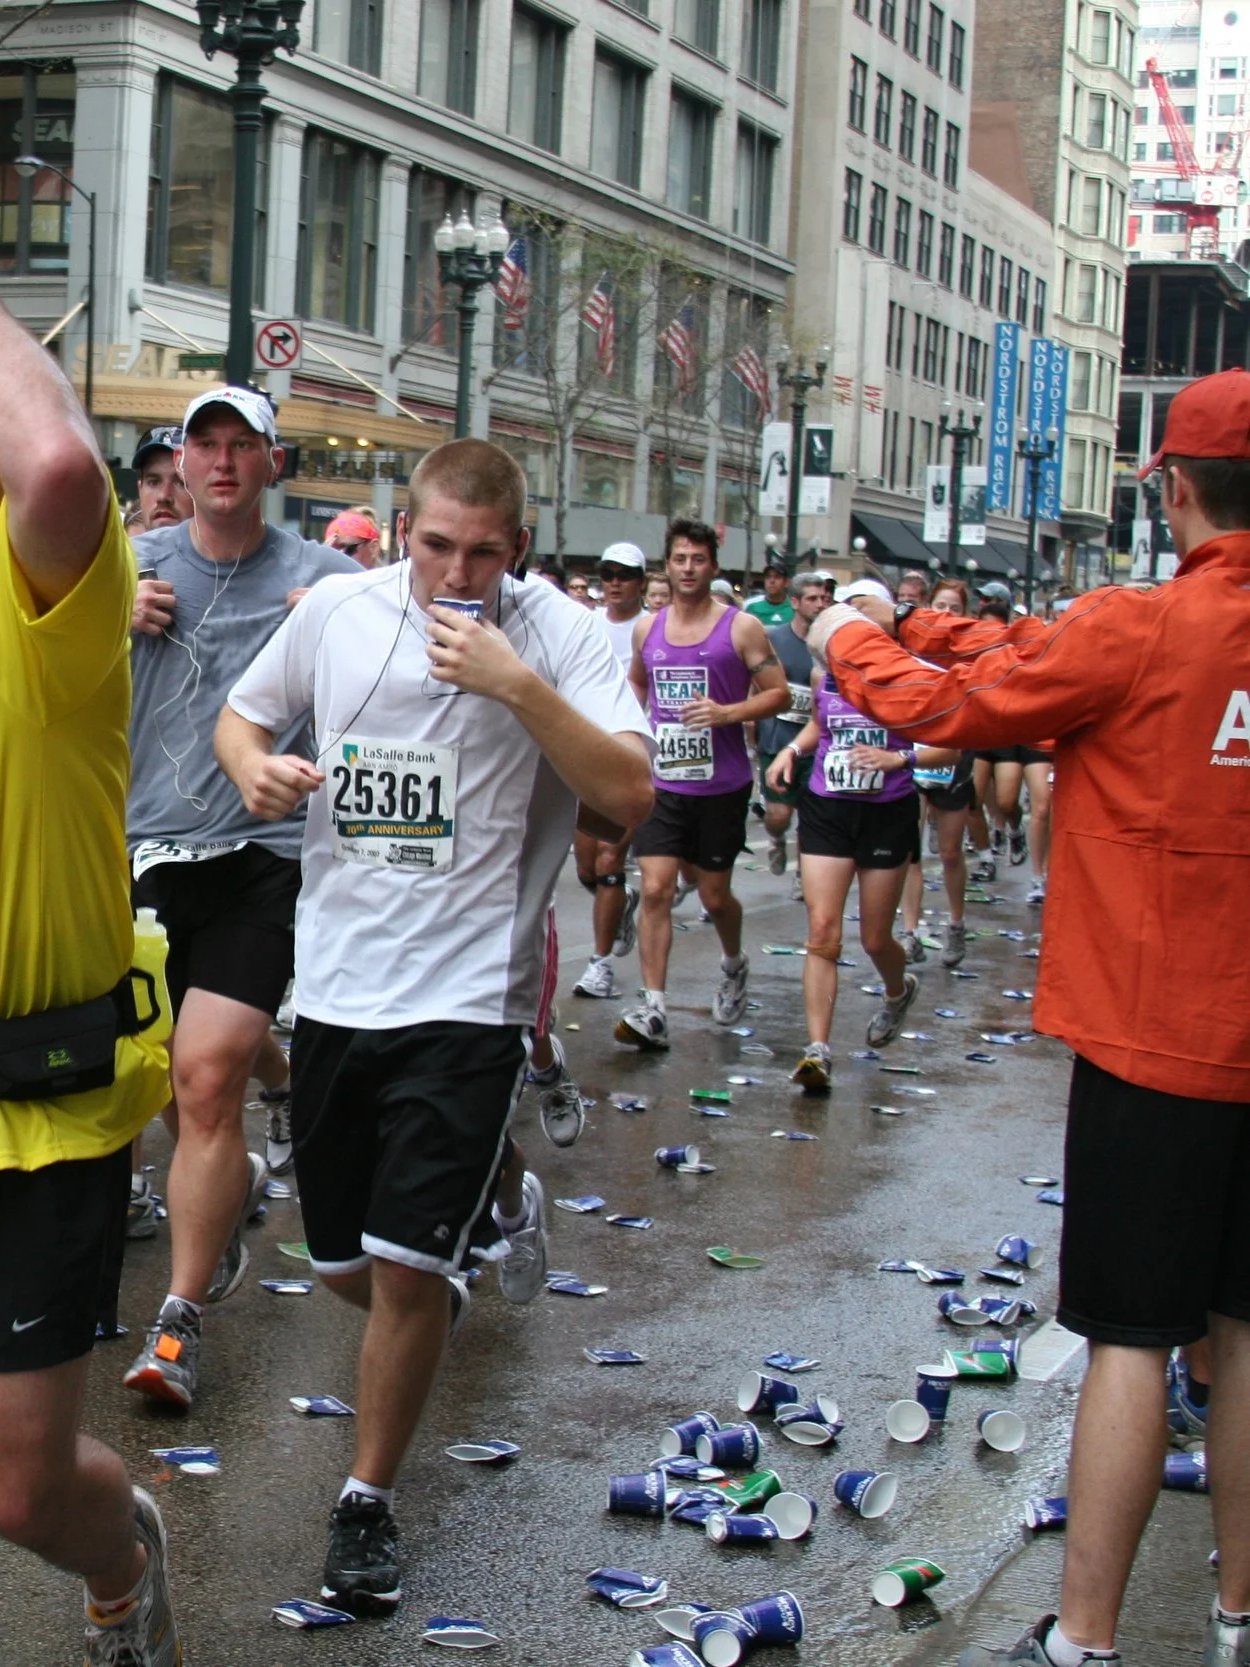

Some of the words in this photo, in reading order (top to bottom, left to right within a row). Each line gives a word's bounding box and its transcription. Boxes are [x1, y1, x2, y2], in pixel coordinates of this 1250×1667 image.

[11, 118, 75, 142] SEA
[993, 324, 1014, 449] NORDSTROM
[304, 460, 396, 478] SEARS
[656, 682, 706, 699] TEAM
[836, 729, 886, 746] TEAM
[363, 747, 404, 762] LaSalle
[406, 751, 437, 764] Bank
[332, 765, 444, 822] 25361
[368, 824, 444, 836] ANNIVERSARY
